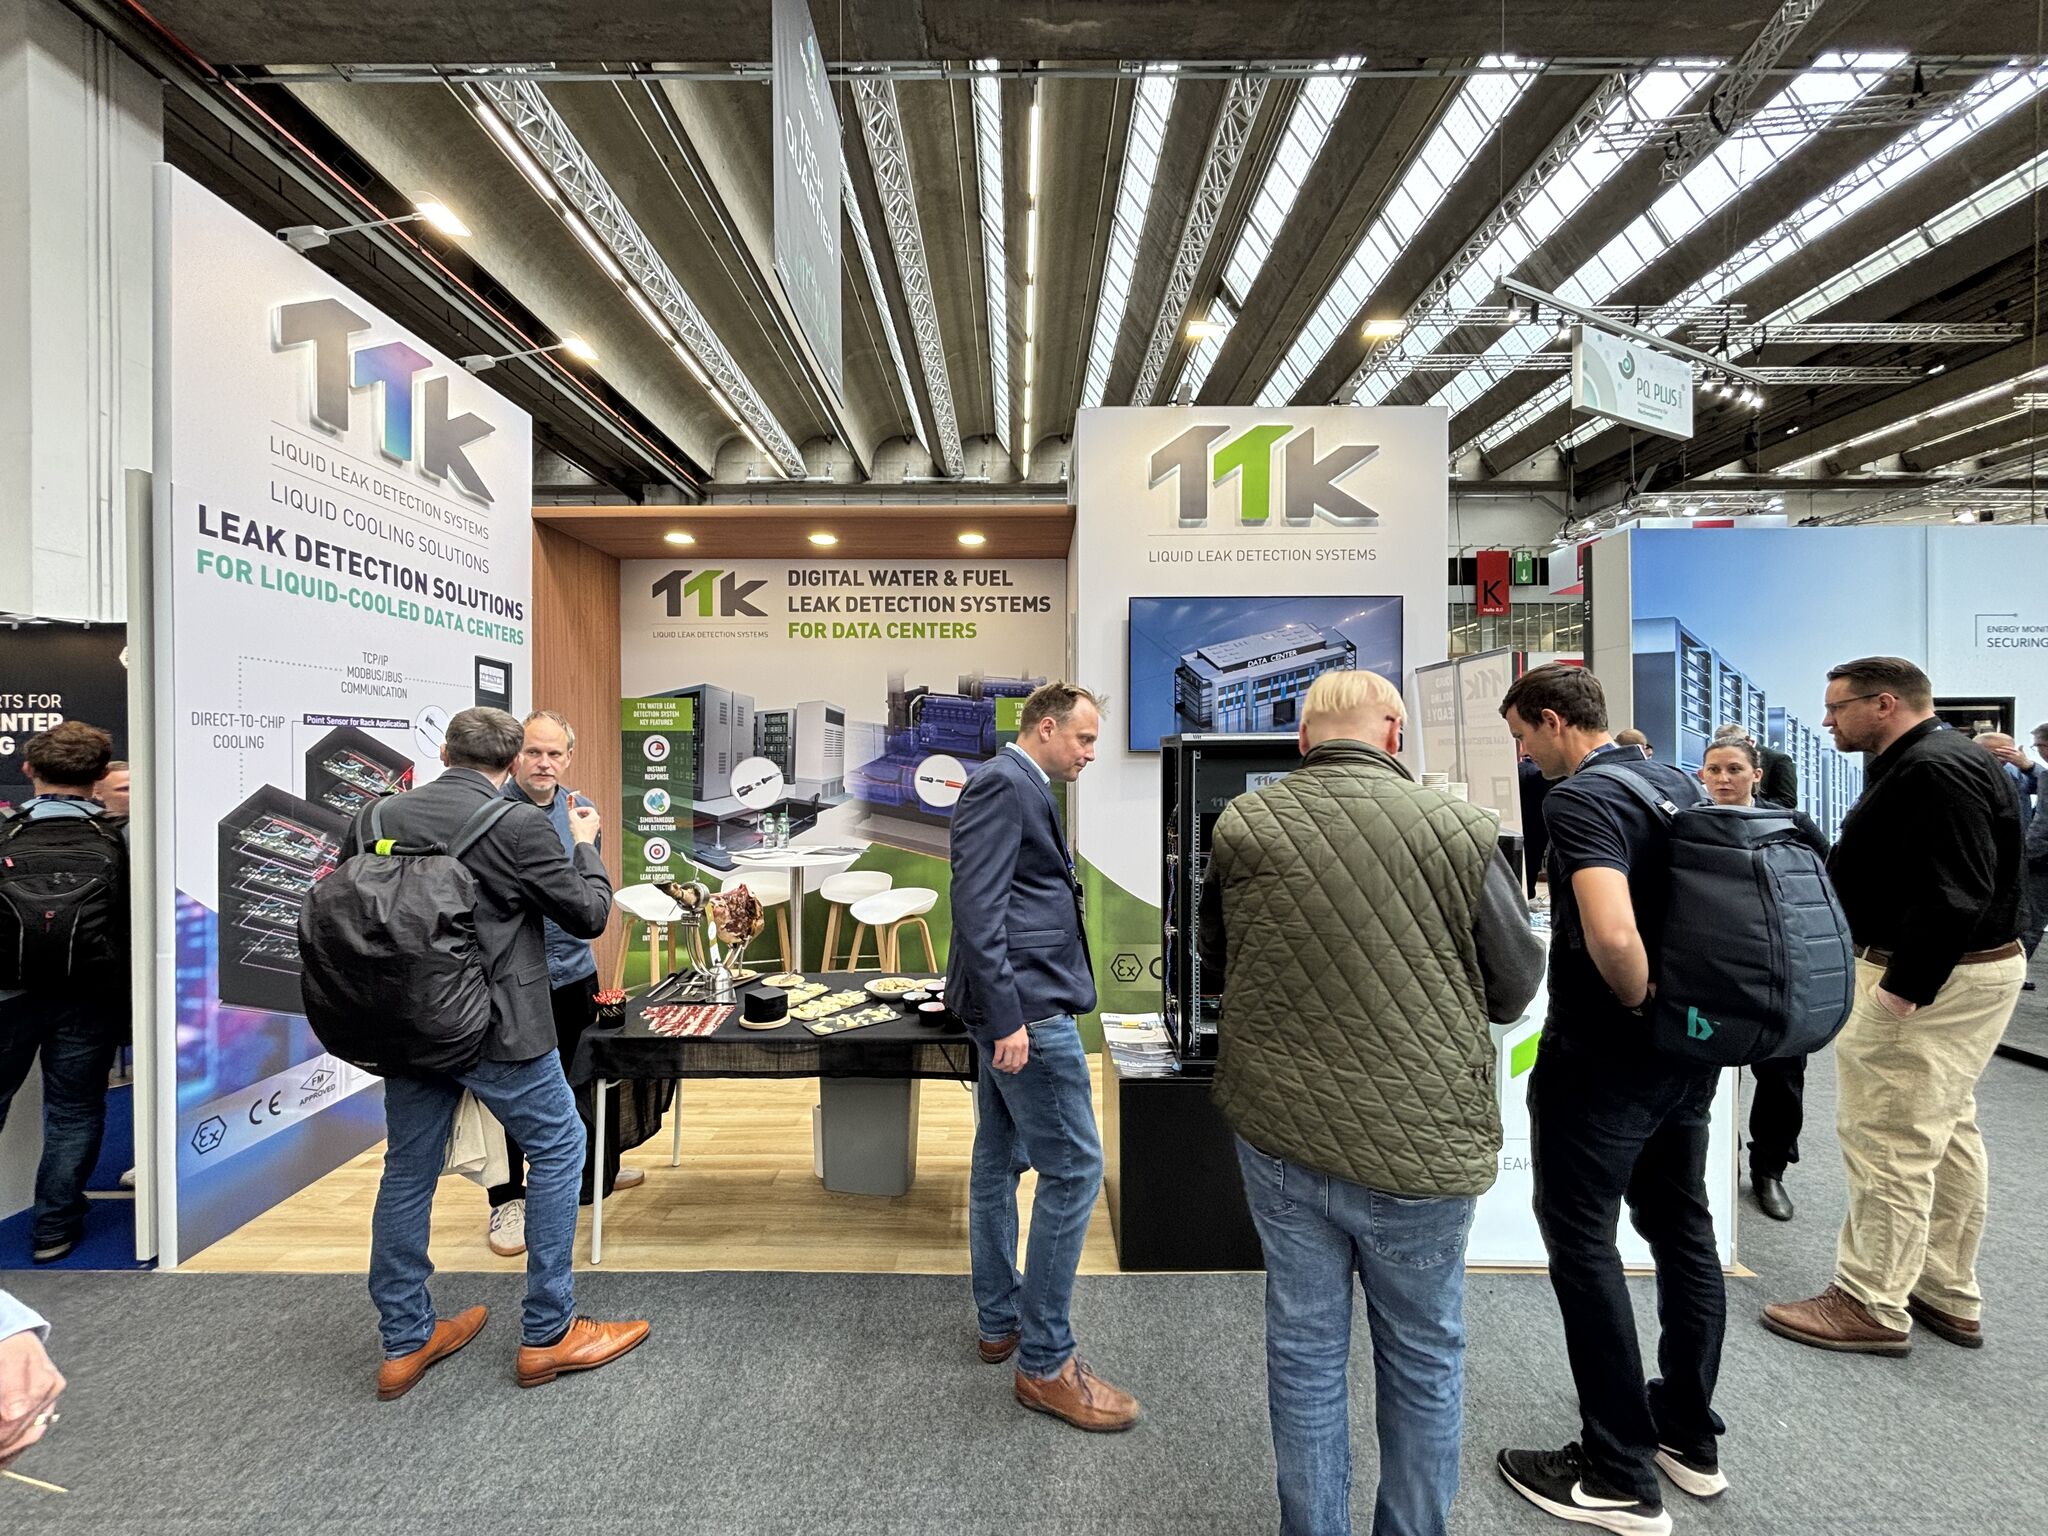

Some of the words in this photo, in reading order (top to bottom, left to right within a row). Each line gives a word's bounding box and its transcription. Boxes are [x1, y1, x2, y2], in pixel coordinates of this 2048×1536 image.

[798, 109, 824, 203] TECH
[785, 115, 834, 265] QUARTIER
[1637, 377, 1650, 399] PQ
[1654, 383, 1677, 407] PLUS
[270, 435, 326, 473] LIQUID
[331, 461, 369, 491] LEAK
[373, 479, 441, 521] DETECTION
[444, 510, 489, 540] SYSTEMS
[271, 480, 337, 521] LIQUID
[343, 508, 415, 548] COOLING
[418, 535, 490, 574] SOLUTIONS
[198, 503, 288, 558] LEAK
[295, 533, 428, 596] DETECTION
[433, 577, 524, 621] SOLUTIONS
[1149, 550, 1194, 563] LIQUID
[1197, 550, 1233, 562] LEAK
[1236, 549, 1312, 562] DETECTION
[1315, 549, 1377, 561] SYSTEMS
[788, 569, 865, 587] DIGITAL
[868, 569, 939, 587] WATER
[943, 569, 958, 587] &
[963, 569, 1014, 587] FUEL
[196, 548, 254, 585] FOR
[260, 564, 420, 622] LIQUID-COOLED
[424, 606, 464, 632] DATA
[467, 617, 524, 646] CENTERS
[1483, 580, 1502, 605] K
[788, 595, 841, 613] LEAK
[846, 595, 955, 613] DETECTION
[960, 595, 1051, 613] SYSTEMS
[652, 631, 676, 639] LIQUID
[697, 631, 736, 639] DETECTION
[788, 622, 827, 639] FOR
[832, 622, 883, 639] DATA
[886, 622, 977, 639] CENTERS
[1987, 625, 2020, 633] ENERGY
[1987, 637, 2048, 648] SECURING
[361, 651, 389, 667] TCP/IP
[1247, 657, 1267, 668] DATA
[1270, 649, 1298, 662] CENTER
[346, 665, 403, 683] MODBUS/JBUS
[341, 681, 408, 699] COMMUNICATION
[28, 694, 62, 708] FOR
[191, 711, 285, 728] DIRECT-TO-CHIP
[306, 715, 326, 725] Point
[326, 716, 349, 726] Sensor
[349, 717, 359, 726] for
[359, 718, 375, 727] Rack
[375, 719, 408, 729] Application
[633, 710, 660, 718] DETECTION
[660, 710, 680, 718] SYSTEM
[640, 718, 649, 726] KEY
[649, 718, 674, 726] FEATURES
[213, 734, 264, 749] COOLING
[646, 765, 667, 773] INSTANT
[637, 824, 650, 832] LEAK
[650, 824, 677, 832] DETECTION
[639, 816, 675, 824] SIMULTANEOUS
[645, 865, 670, 873] ACCURATE
[311, 1073, 325, 1087] FM
[299, 1083, 336, 1107] APPROVED
[248, 1090, 282, 1126] CE
